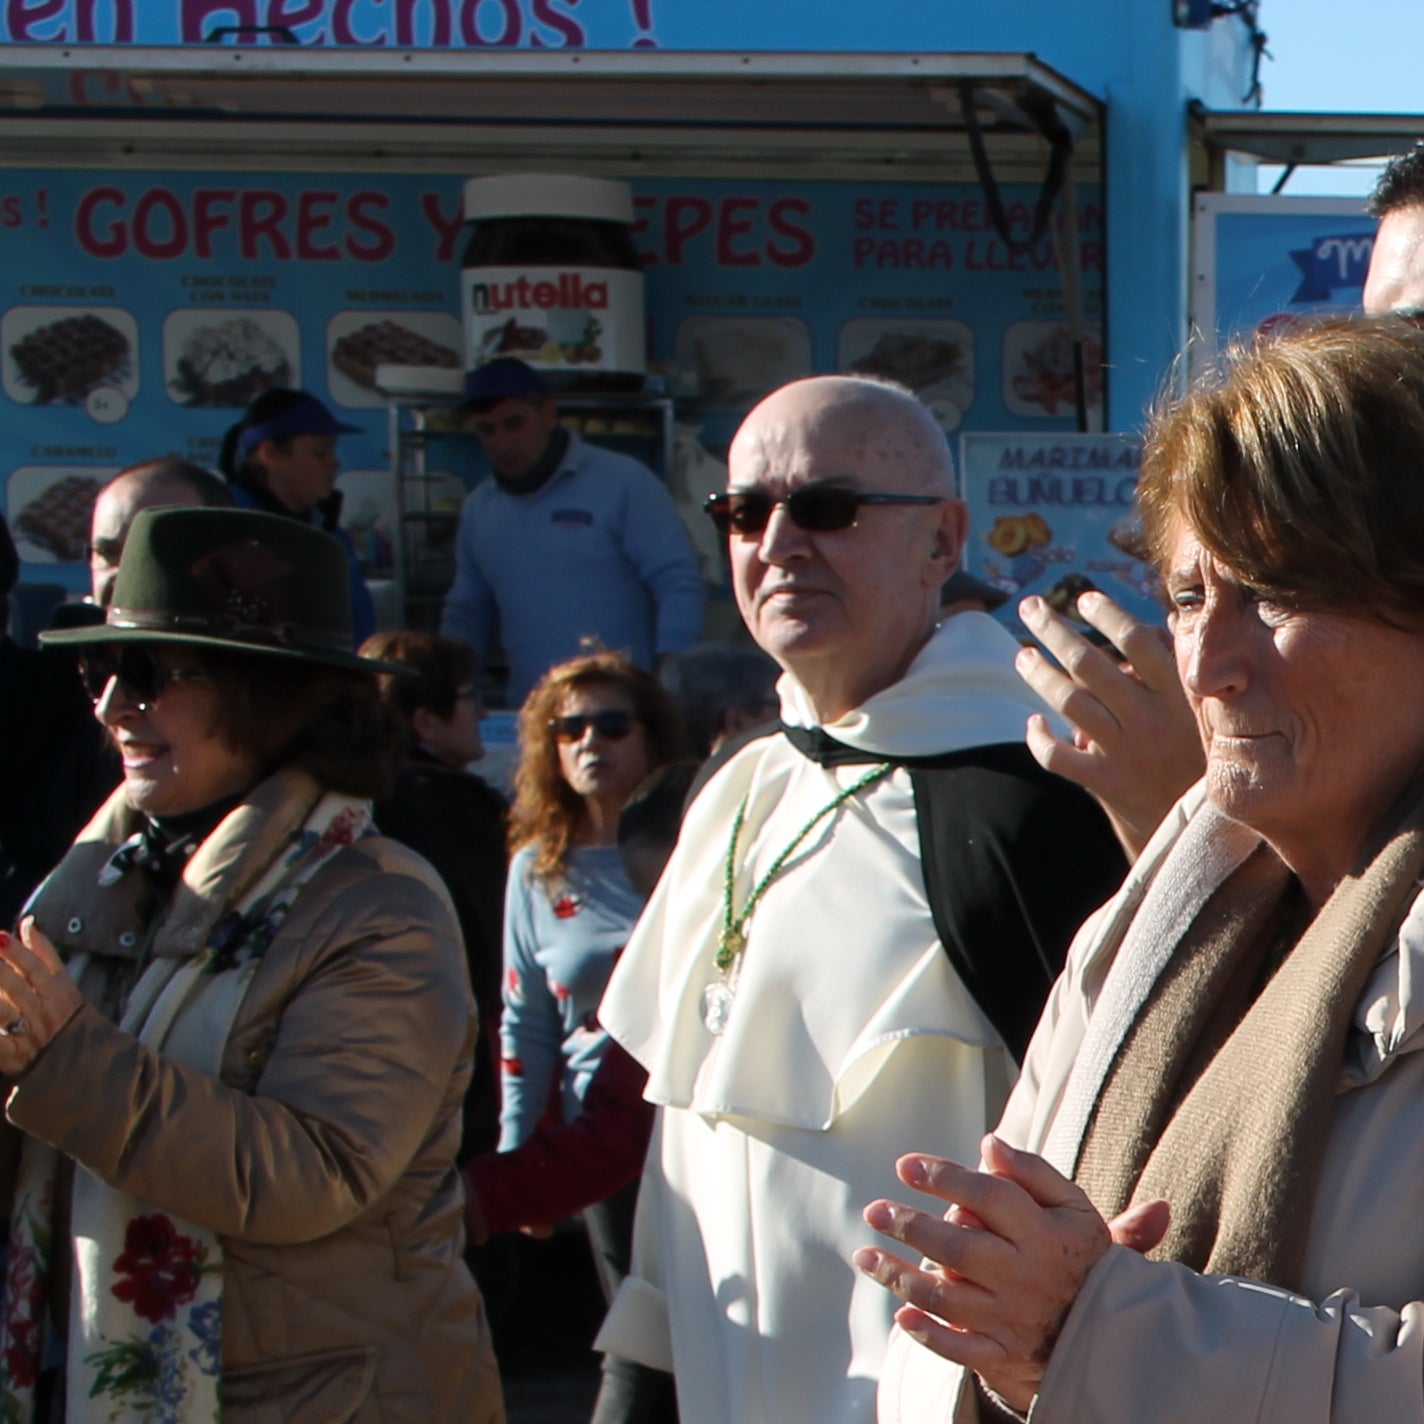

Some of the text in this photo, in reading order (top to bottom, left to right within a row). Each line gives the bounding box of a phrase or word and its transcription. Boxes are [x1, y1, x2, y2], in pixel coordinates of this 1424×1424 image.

[75, 186, 396, 264] GOFRES
[421, 192, 465, 262] Y
[853, 198, 899, 230] SE
[853, 237, 1105, 271] PARA LLEVR
[472, 273, 609, 311] nutella
